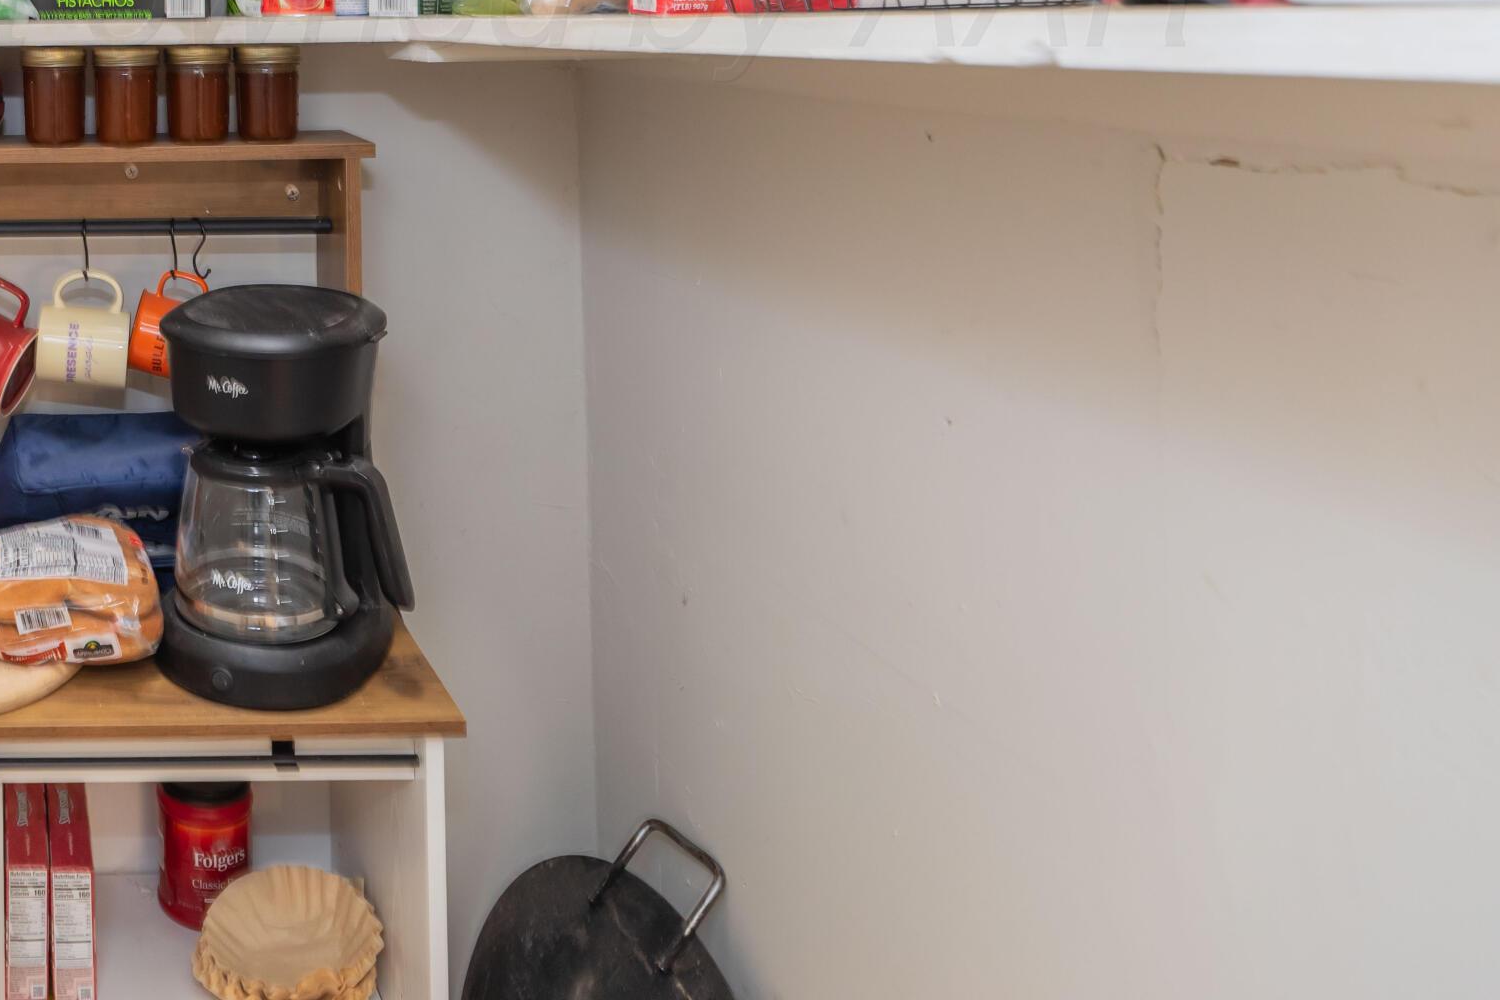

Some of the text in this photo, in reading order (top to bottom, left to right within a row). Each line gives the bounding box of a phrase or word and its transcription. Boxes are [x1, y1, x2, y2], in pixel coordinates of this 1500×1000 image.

[65, 322, 80, 383] PRESENCE
[207, 378, 249, 399] Mr. Coffee
[269, 527, 277, 535] 10
[212, 571, 254, 594] Mr. Coffee
[193, 848, 245, 872] Folgers
[191, 879, 226, 890] Classic
